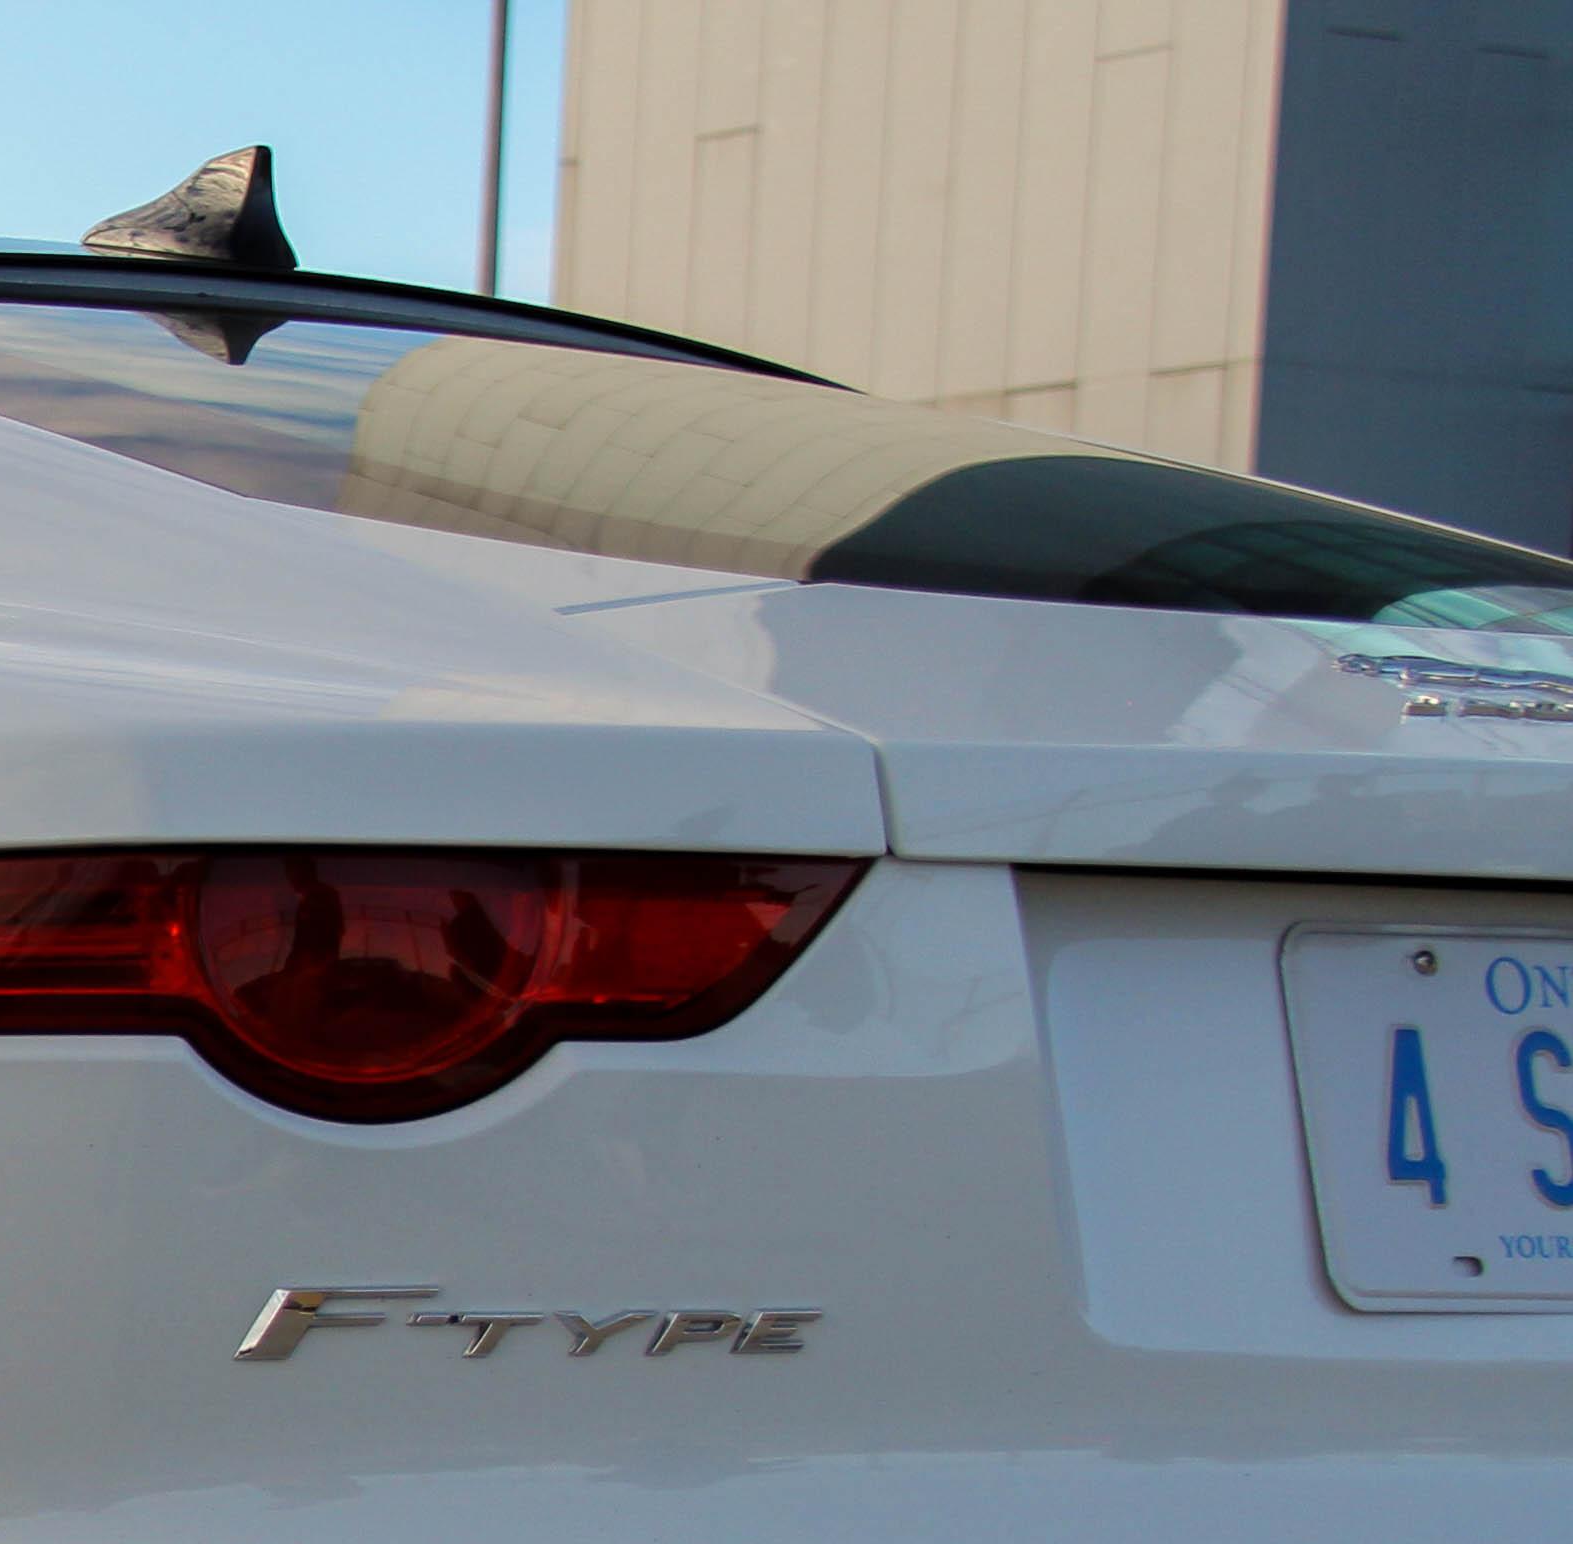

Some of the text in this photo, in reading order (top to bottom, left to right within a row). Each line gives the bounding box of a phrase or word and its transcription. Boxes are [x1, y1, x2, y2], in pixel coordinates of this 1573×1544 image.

[1485, 956, 1573, 1015] ON
[1387, 1028, 1447, 1206] 4
[232, 1286, 824, 1361] F-TYPE
